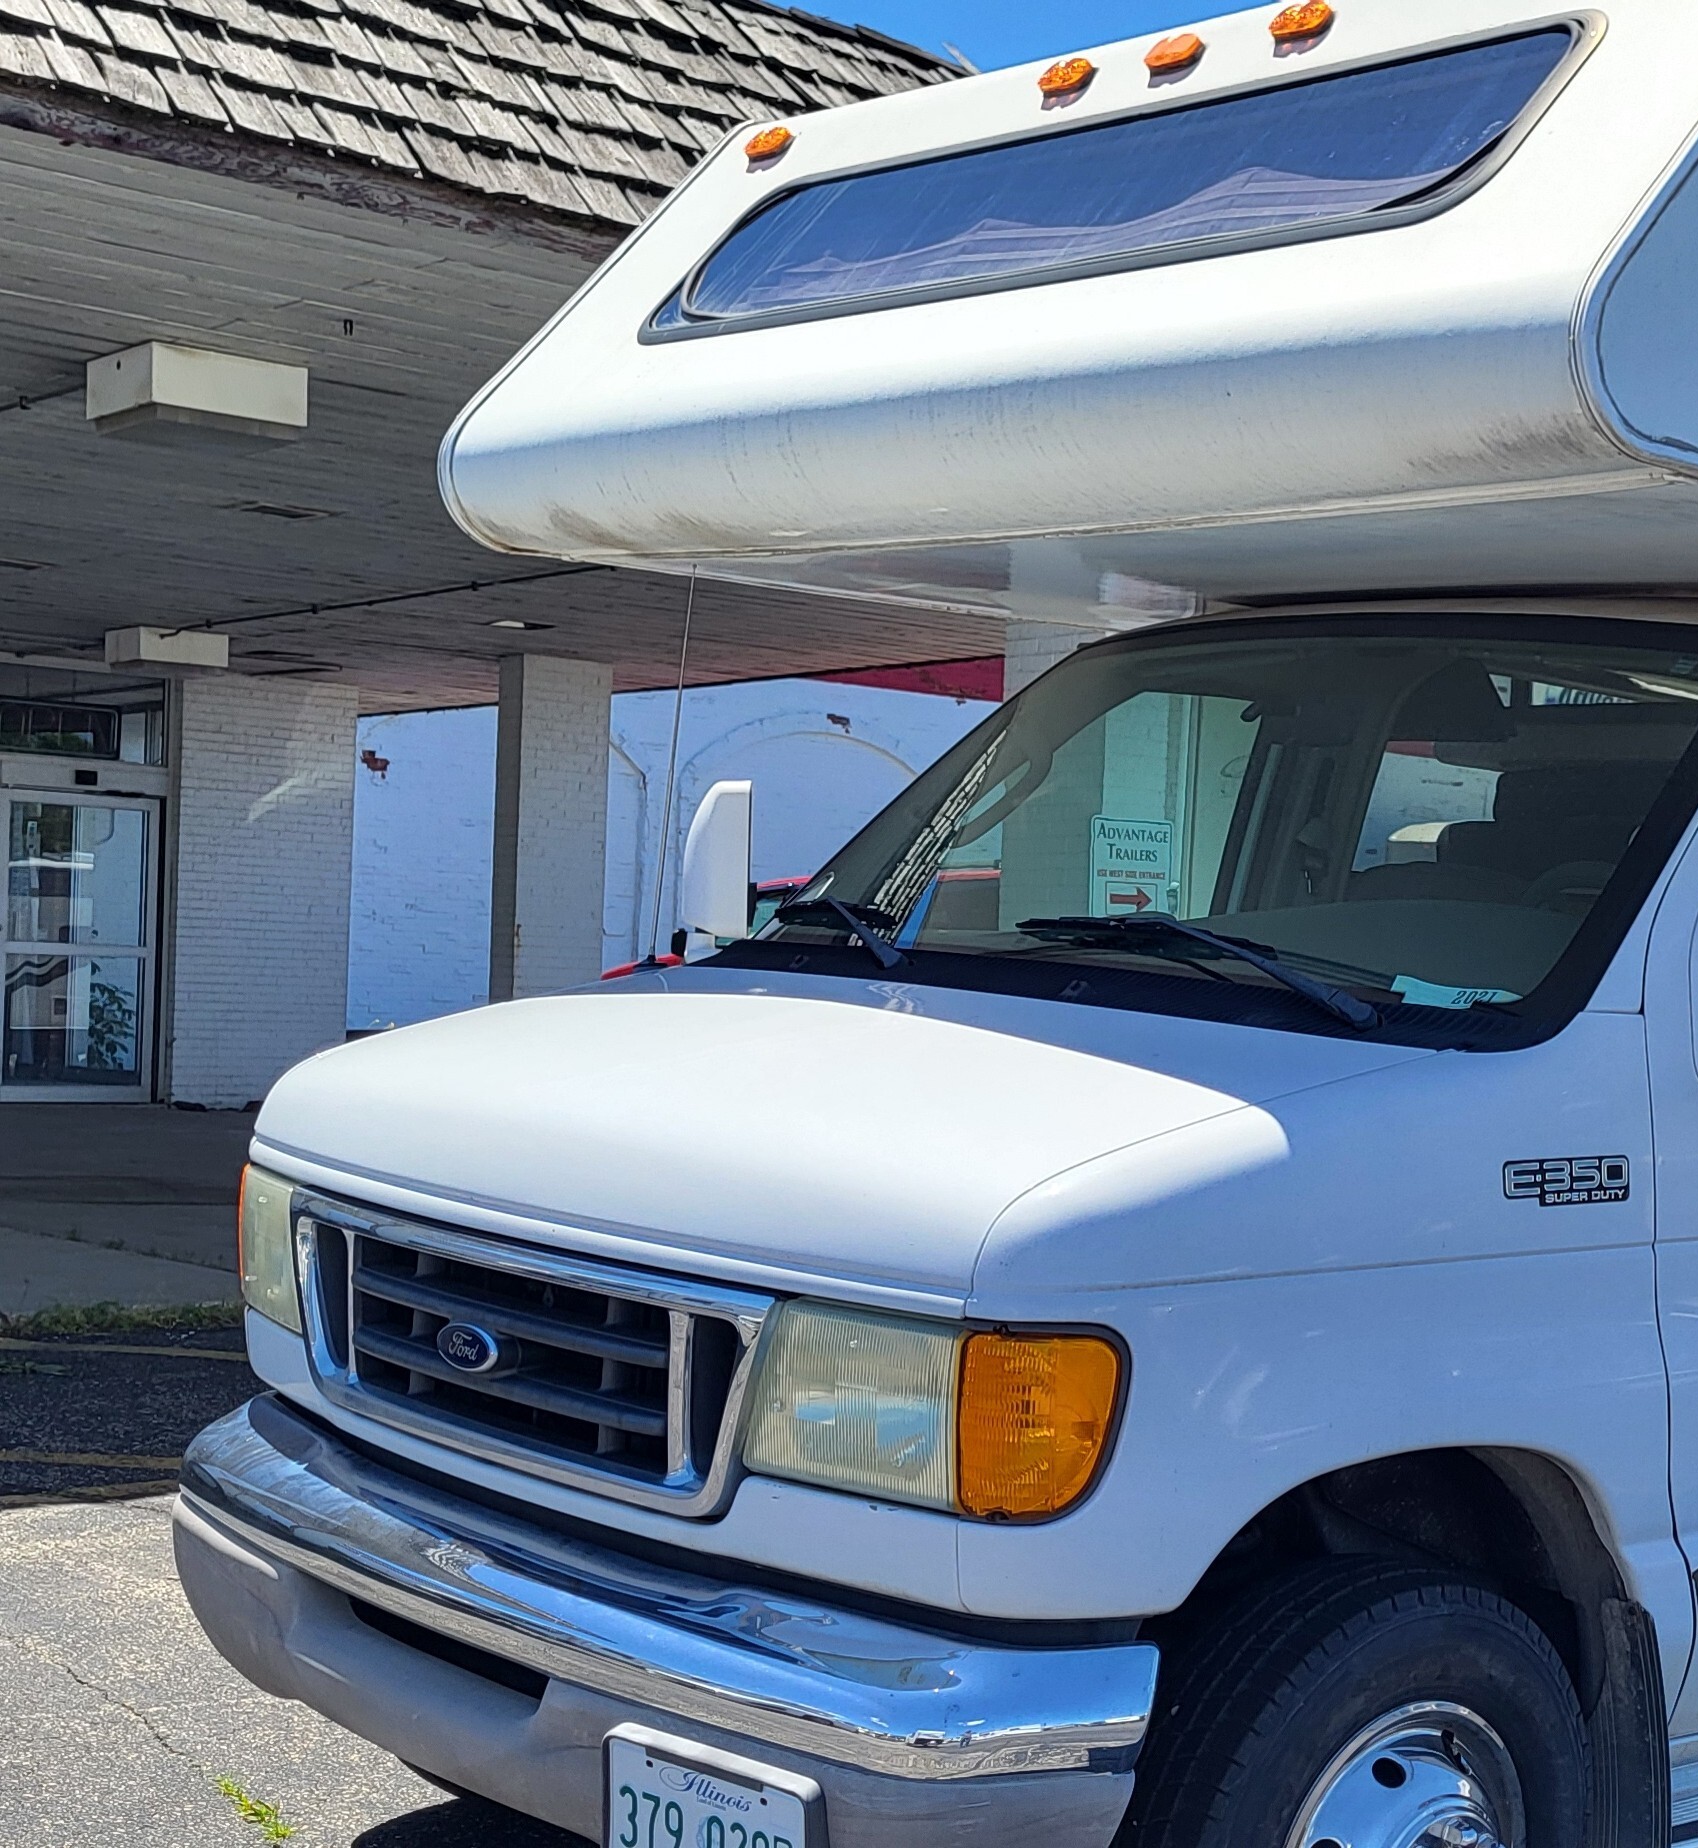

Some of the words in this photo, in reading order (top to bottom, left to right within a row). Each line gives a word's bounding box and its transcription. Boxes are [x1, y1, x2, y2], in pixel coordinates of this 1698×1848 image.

[1097, 822, 1169, 843] ADVANTAGE
[1106, 843, 1158, 862] TRAILERS
[1451, 990, 1498, 1005] 2021
[1545, 1191, 1588, 1203] SUPER
[1591, 1189, 1625, 1200] DUTY
[448, 1331, 480, 1361] Ford
[659, 1766, 753, 1812] Illinois
